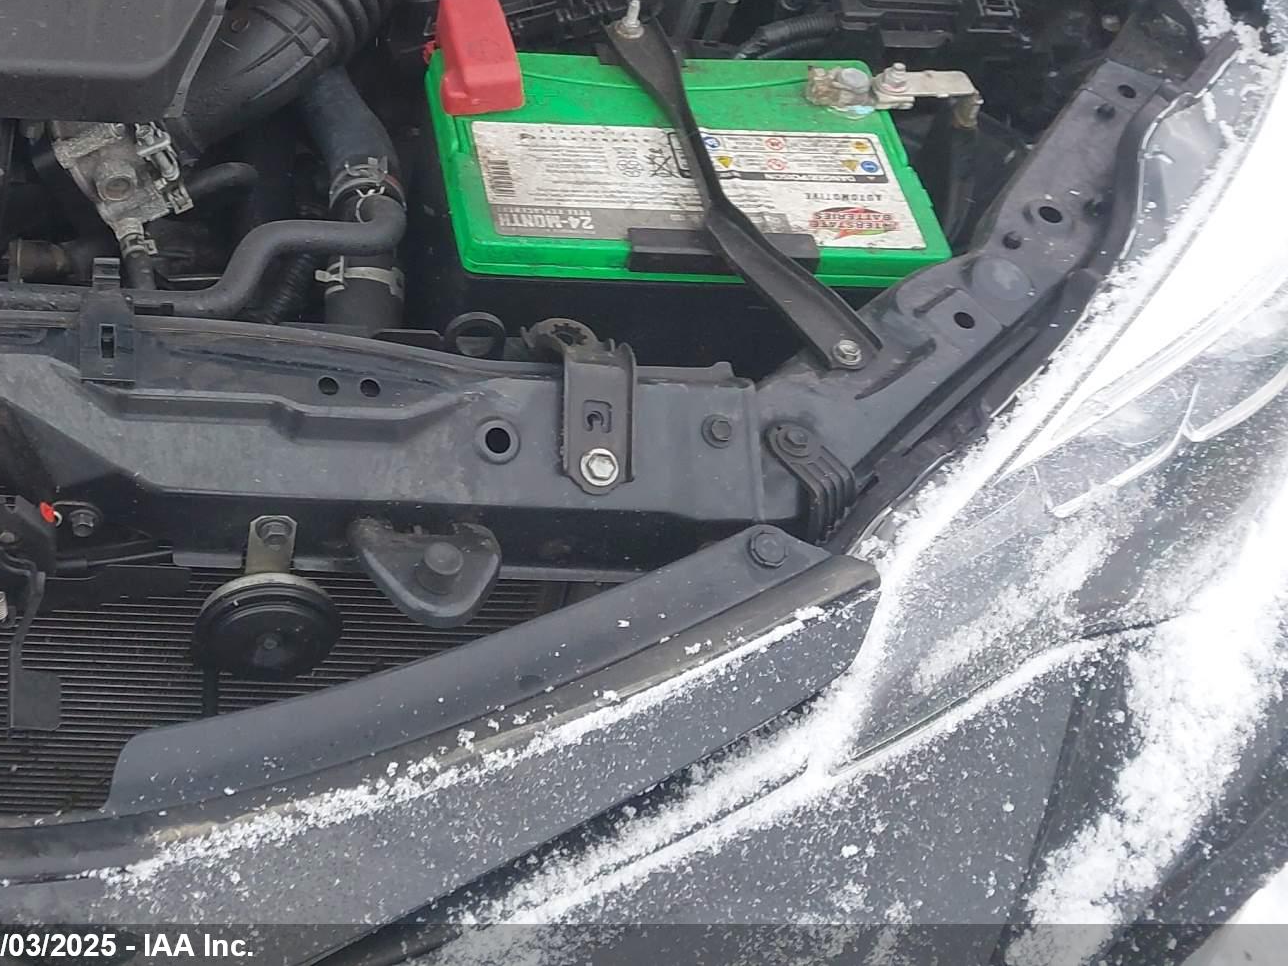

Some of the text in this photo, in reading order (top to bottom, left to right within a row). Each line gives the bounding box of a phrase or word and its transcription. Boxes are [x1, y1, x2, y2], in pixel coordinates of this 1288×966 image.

[804, 191, 883, 202] AUTOMOTIVE
[813, 211, 893, 221] BATTERIES
[497, 214, 596, 230] 24-MONTH
